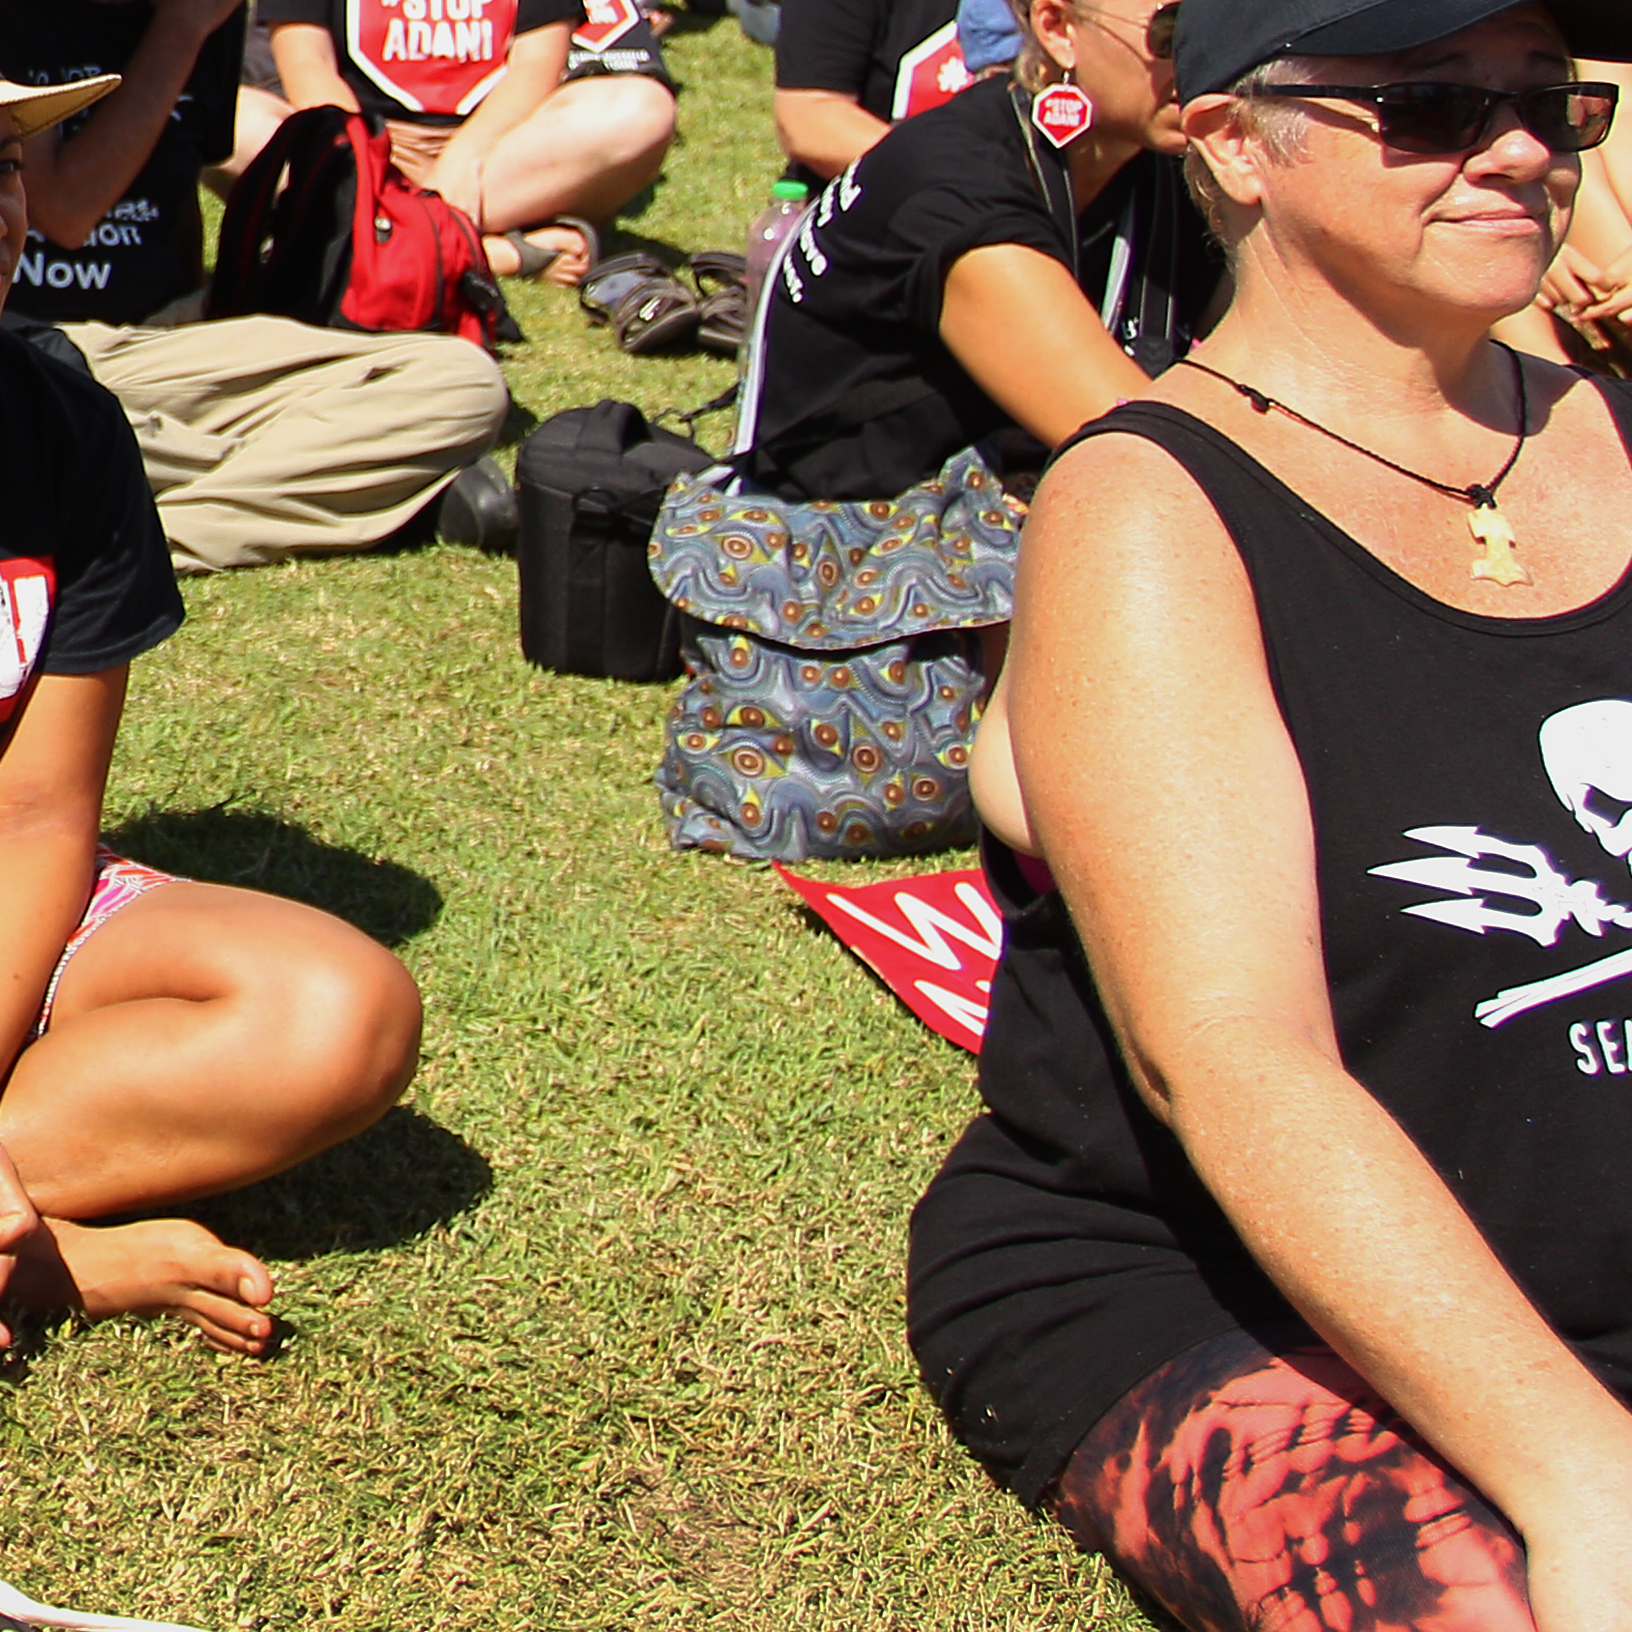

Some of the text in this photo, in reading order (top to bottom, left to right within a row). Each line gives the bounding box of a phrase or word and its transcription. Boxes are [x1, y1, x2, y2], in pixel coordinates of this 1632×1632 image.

[382, 18, 493, 63] ADANI
[12, 251, 112, 290] Now
[1569, 1019, 1632, 1075] SE
